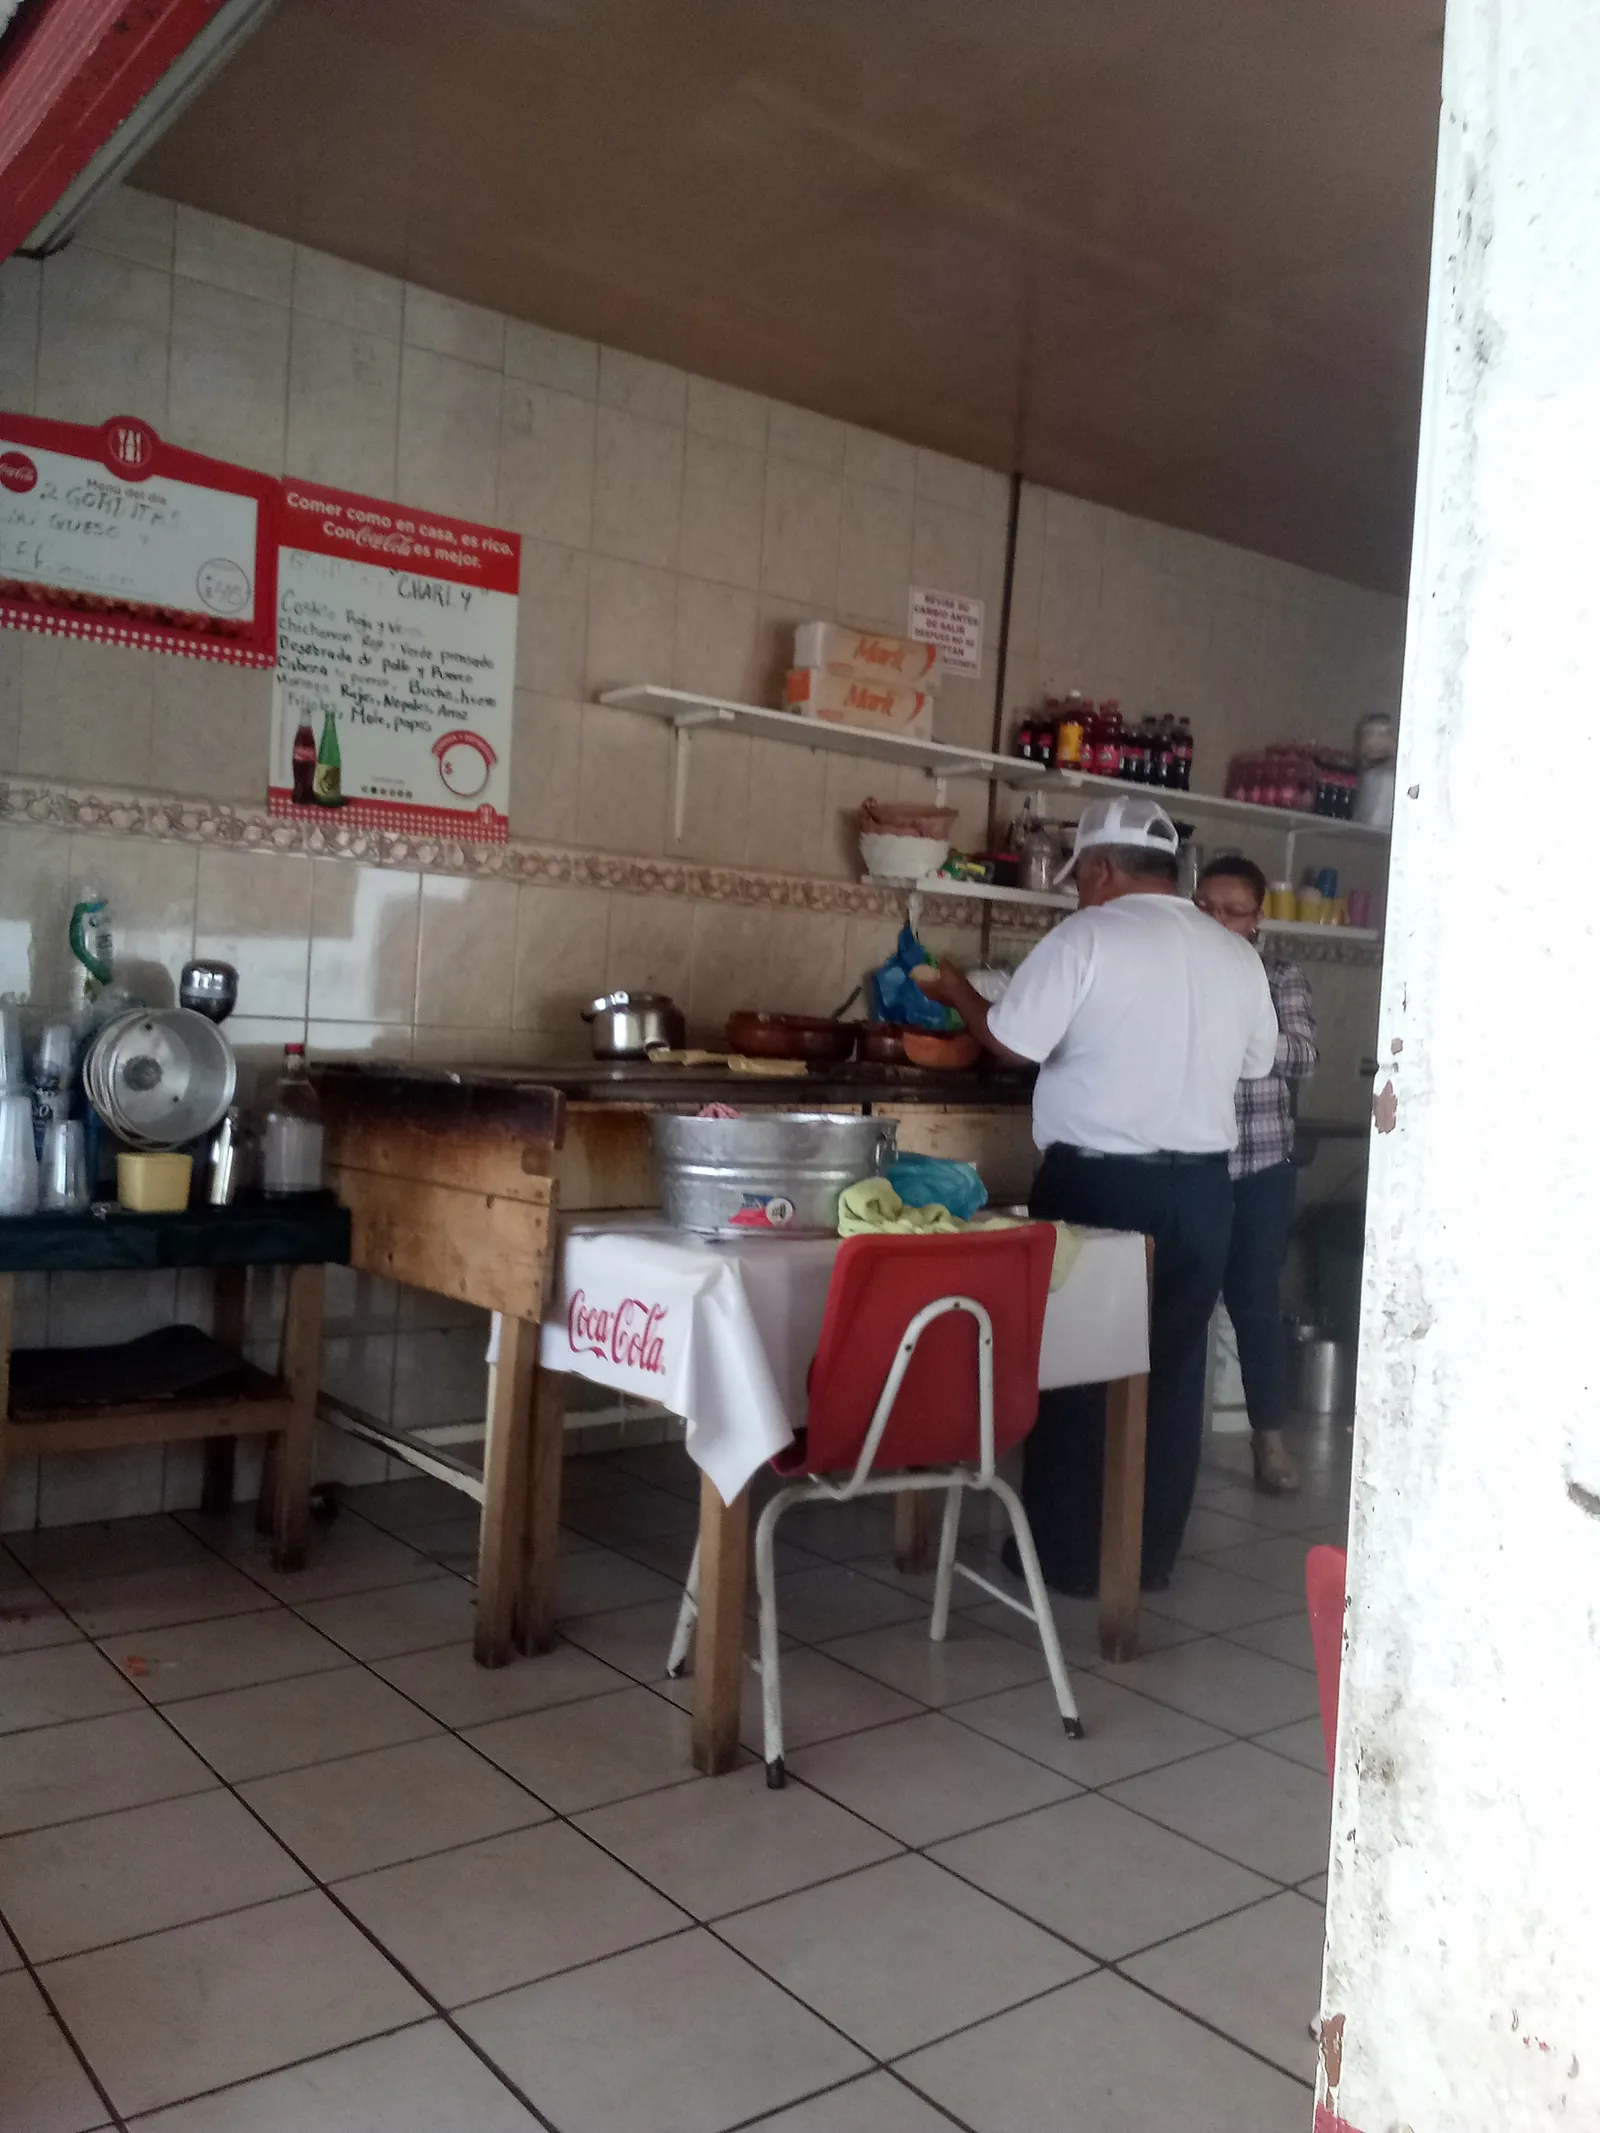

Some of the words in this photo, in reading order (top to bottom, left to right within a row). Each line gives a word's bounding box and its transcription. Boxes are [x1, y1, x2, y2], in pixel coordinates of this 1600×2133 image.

[285, 491, 343, 518] Comer
[345, 507, 393, 530] como
[395, 518, 416, 534] en
[418, 522, 458, 546] casa,
[460, 533, 479, 548] es
[323, 520, 356, 543] Con
[414, 542, 432, 560] es
[434, 545, 483, 569] mejor.
[567, 1288, 669, 1376] Coca-Cola
